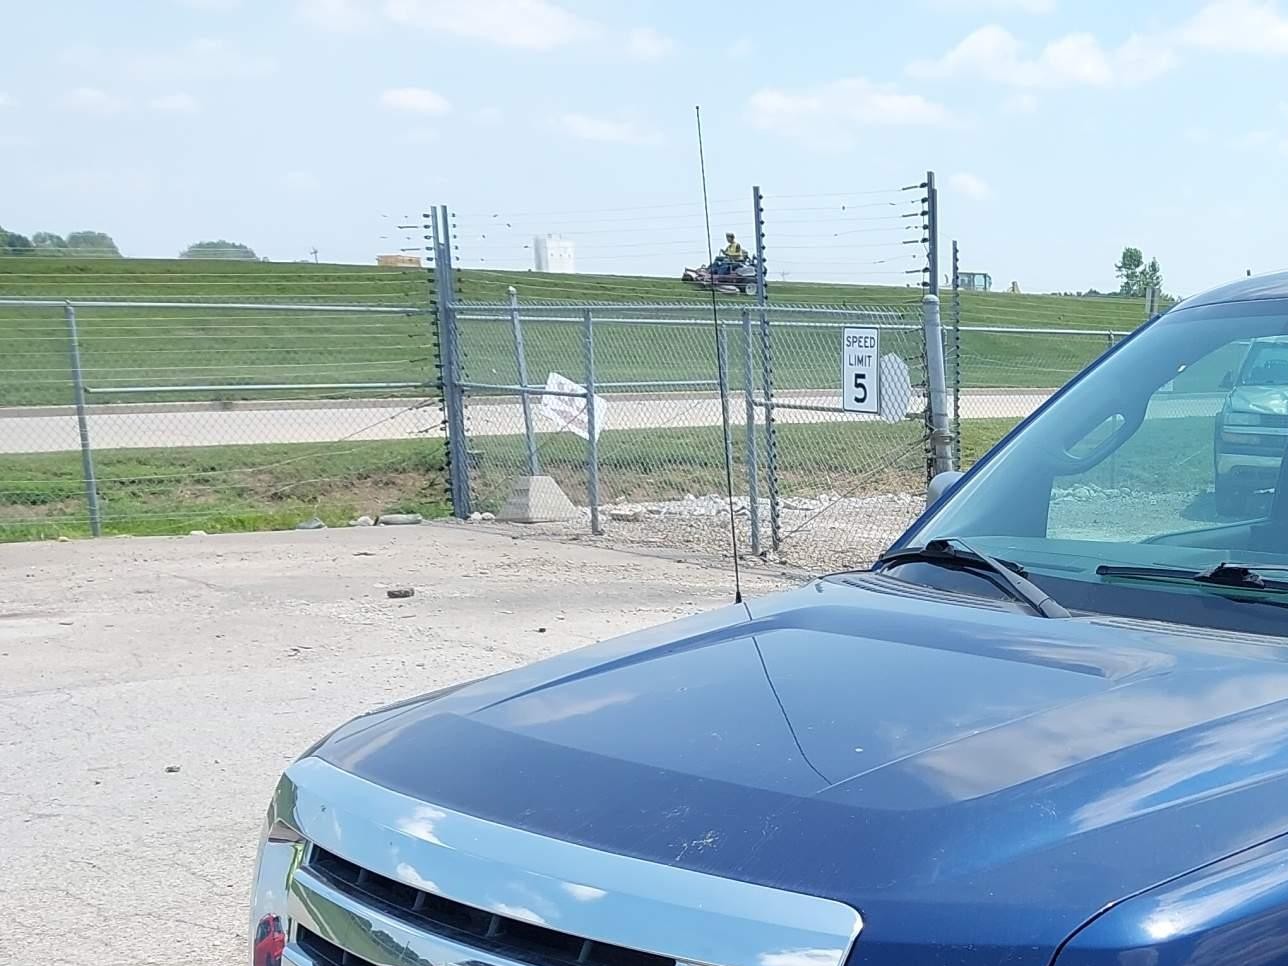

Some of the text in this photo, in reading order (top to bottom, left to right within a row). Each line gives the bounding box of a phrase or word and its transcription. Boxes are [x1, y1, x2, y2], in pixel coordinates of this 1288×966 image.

[846, 335, 875, 348] SPEED
[848, 354, 872, 367] LIMIT
[853, 373, 867, 403] 5
